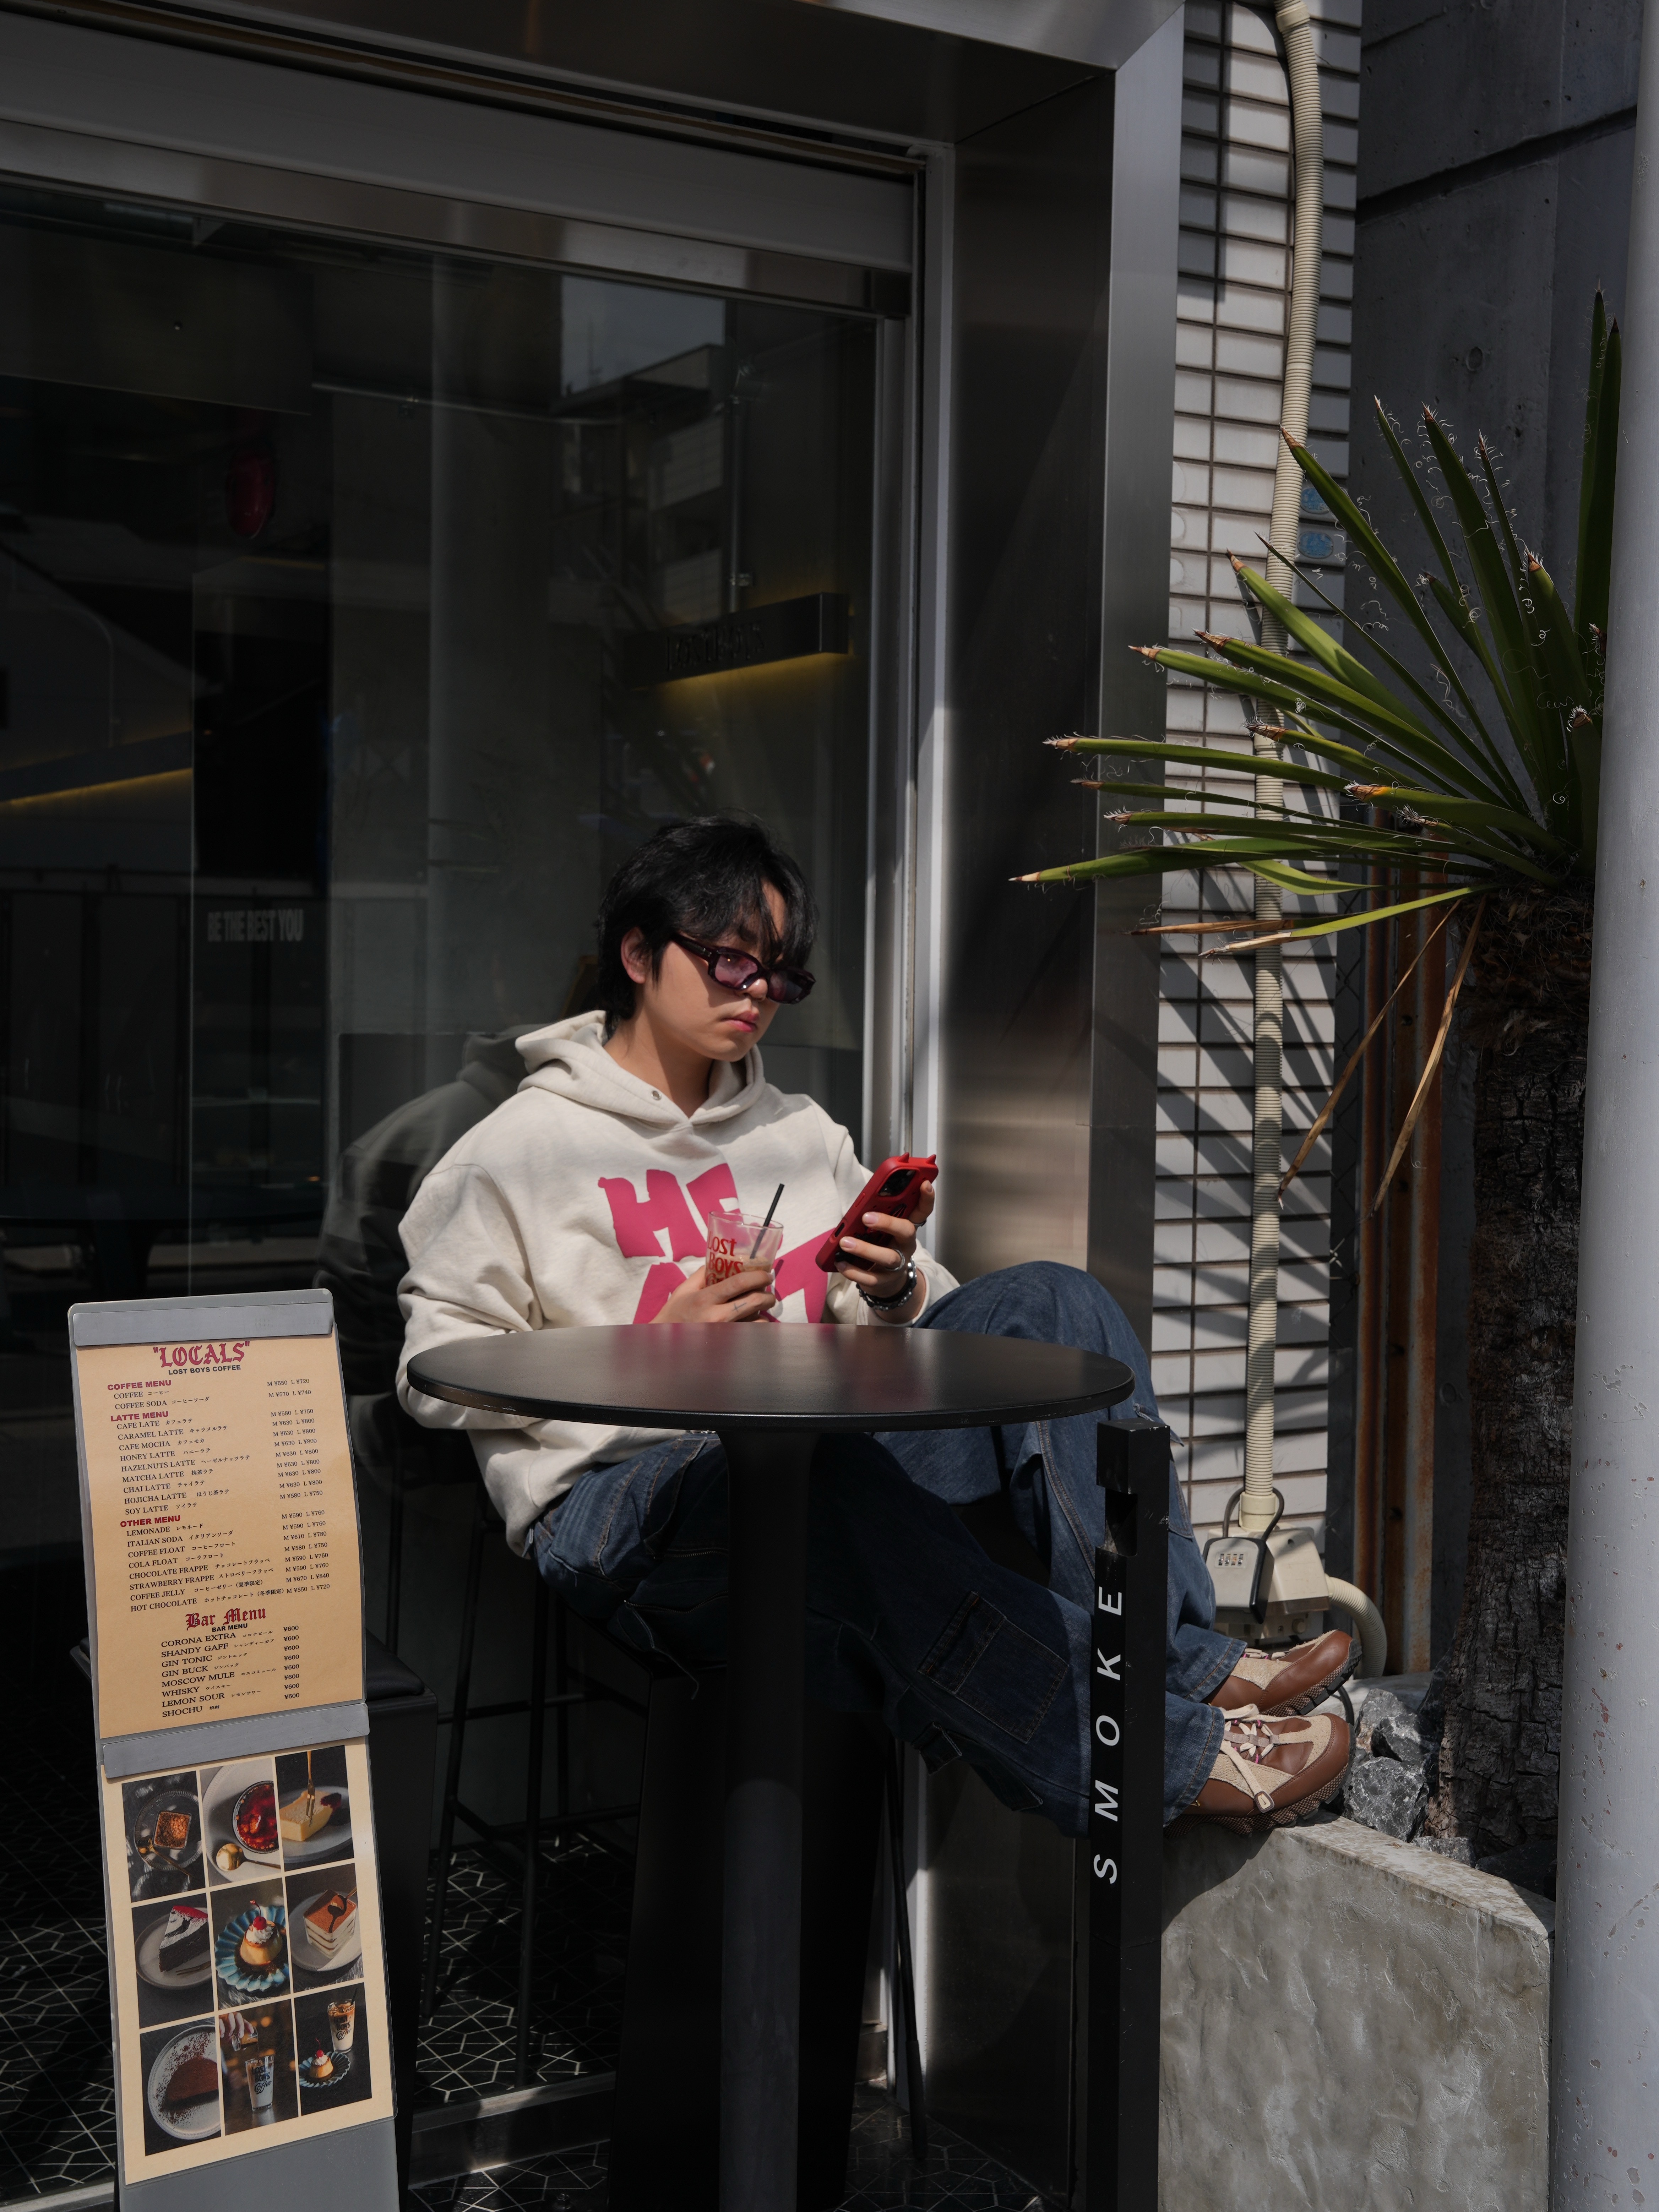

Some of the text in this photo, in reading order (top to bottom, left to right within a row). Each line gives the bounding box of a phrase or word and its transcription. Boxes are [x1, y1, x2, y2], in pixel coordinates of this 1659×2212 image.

[207, 909, 304, 942] BE THE BEST YOU
[107, 1379, 172, 1391] COFFEE MENU
[114, 1391, 143, 1399] COFFEE
[110, 1411, 169, 1422] LATTE MENU
[118, 1431, 157, 1440] CARAMEL
[190, 1425, 228, 1433] キャラメルラテ
[141, 1440, 171, 1449] MOCHA
[120, 1453, 148, 1461] HONEY
[121, 1455, 250, 1472] HAZELNUTS LATTE ヘーゼルナッツラテ
[122, 1474, 157, 1483] MATCHA
[158, 1471, 184, 1479] LATTE
[145, 1483, 171, 1491] LATTE
[124, 1495, 160, 1504] HOJICHA
[161, 1492, 187, 1500] LATTE
[142, 1505, 169, 1513] LATTE
[120, 1515, 181, 1527] OTHER MENU
[126, 1526, 170, 1537] LEMONADE
[127, 1538, 160, 1547] ITALIAN
[189, 1530, 234, 1540] イタリアンソーダ
[128, 1541, 235, 1558] COFFEE FLOAT コーヒーフロート
[152, 1557, 178, 1566] FLOAT
[186, 1553, 224, 1561] コーラフロート
[129, 1558, 270, 1580] CHOCOLATE FRAPPE チョコレートフラッペ
[130, 1568, 274, 1590] STRAWBERRY FRAPPE ストロベリーフラッペ
[130, 1592, 160, 1601] COFFEE
[161, 1589, 185, 1597] JELLY
[149, 1598, 197, 1609] CHOCOLATE
[185, 1607, 267, 1631] Bar Menu
[161, 1637, 203, 1647] CORONA
[205, 1632, 237, 1642] EXTRA
[161, 1639, 274, 1658] SHANDY GAFF シャンディーガフ
[161, 1659, 179, 1667] GIN
[181, 1655, 212, 1665] TONIC
[162, 1669, 179, 1677] GIN
[182, 1665, 208, 1675] BUCK
[161, 1676, 206, 1688] MOSCOW
[208, 1672, 235, 1681] MULE
[161, 1686, 200, 1697] WHISKY
[162, 1696, 196, 1708] LEMON
[199, 1693, 225, 1702] SOUR
[162, 1705, 203, 1717] SHOCHU
[1093, 1586, 1122, 1884] SMOKE
